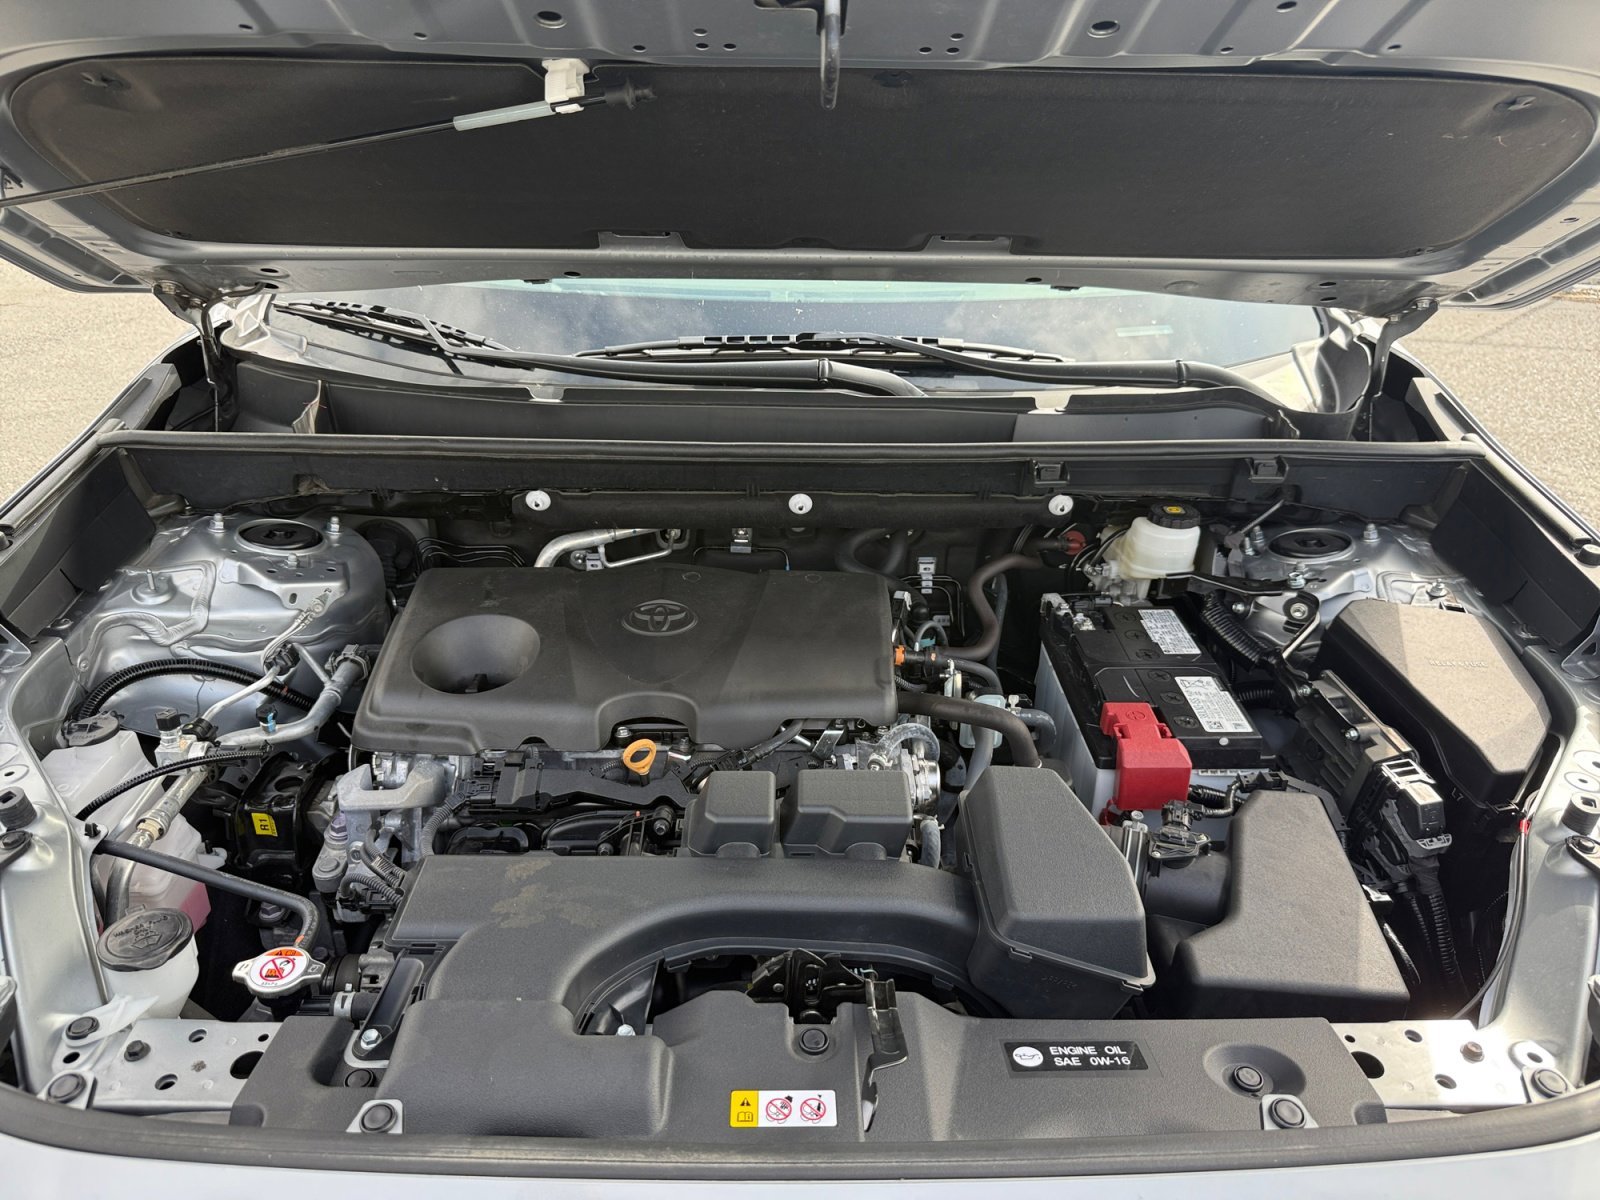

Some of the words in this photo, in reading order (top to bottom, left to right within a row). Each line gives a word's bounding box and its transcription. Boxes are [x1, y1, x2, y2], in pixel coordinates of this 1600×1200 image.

[259, 818, 270, 831] R1
[1049, 1046, 1098, 1056] ENGINE
[1104, 1045, 1127, 1055] OIL
[1054, 1057, 1082, 1067] SAE
[1090, 1056, 1131, 1066] 0W-16
